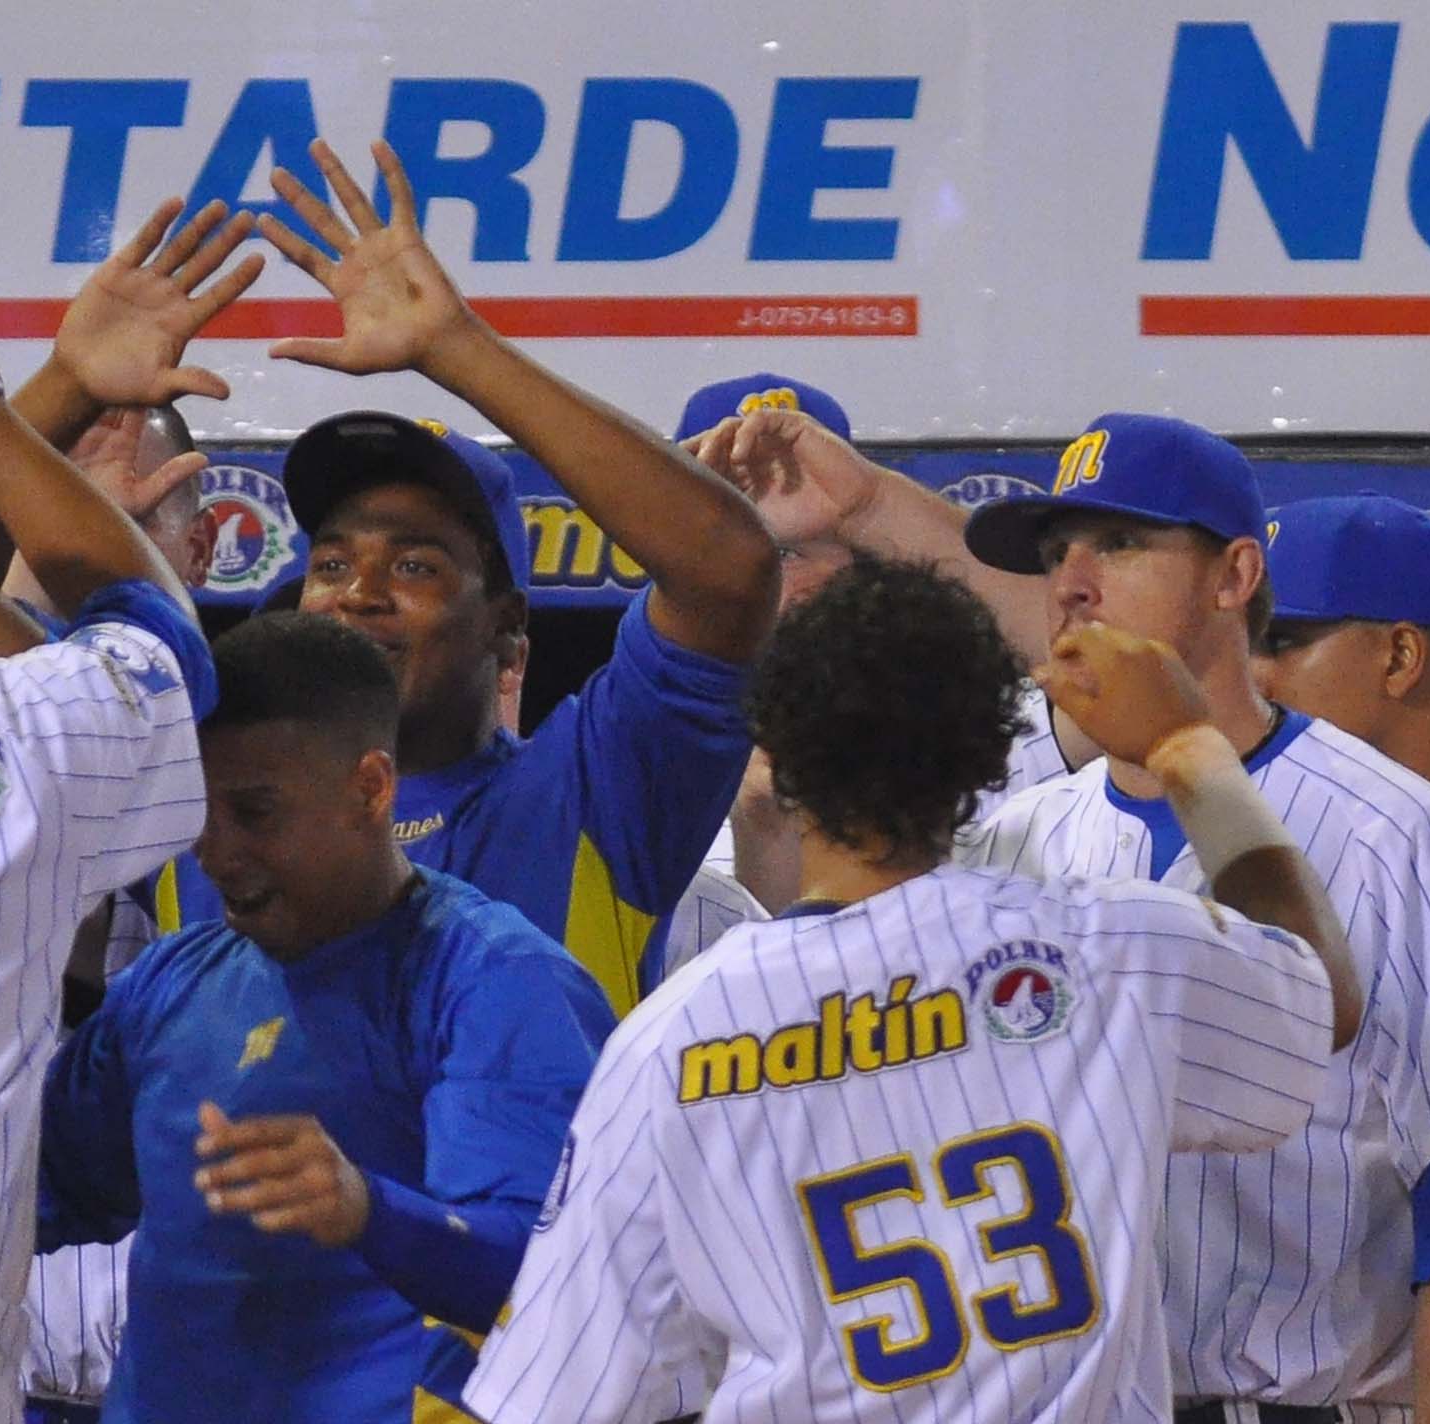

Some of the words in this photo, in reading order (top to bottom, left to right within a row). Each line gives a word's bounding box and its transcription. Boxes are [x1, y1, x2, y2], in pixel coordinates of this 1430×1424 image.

[965, 939, 1071, 996] POLAR
[677, 974, 969, 1105] maltín
[797, 1120, 1104, 1394] 53
